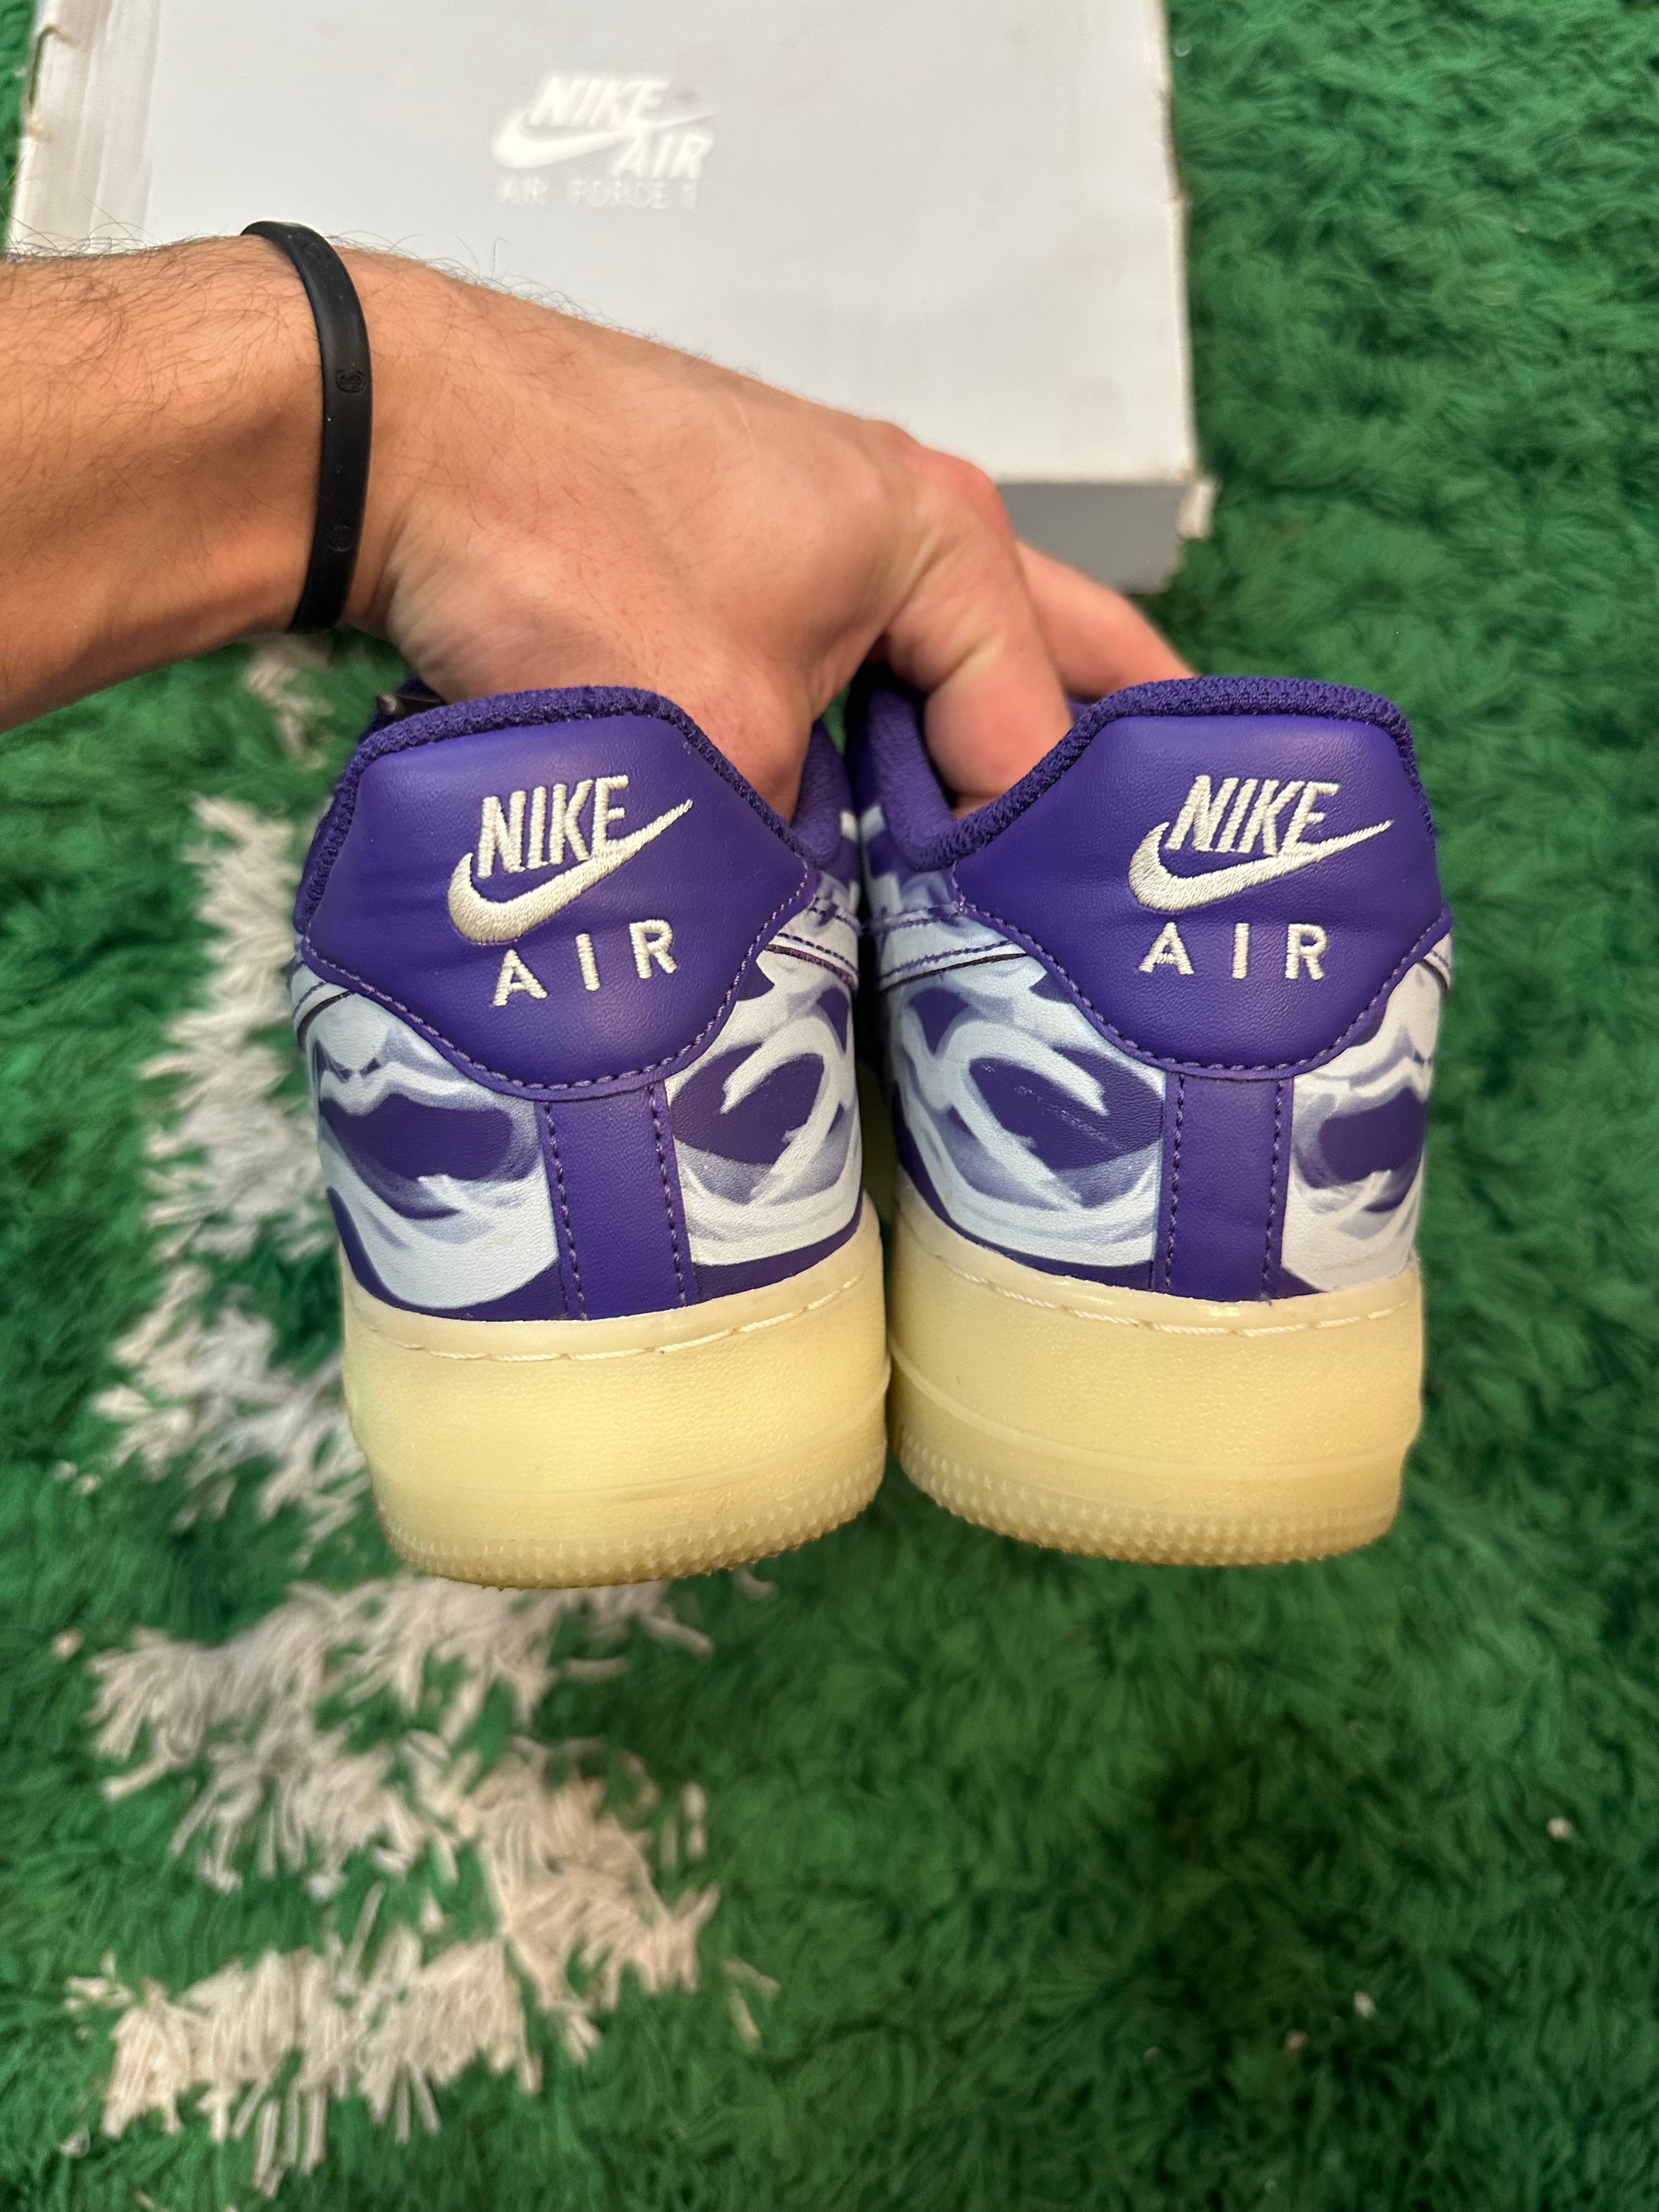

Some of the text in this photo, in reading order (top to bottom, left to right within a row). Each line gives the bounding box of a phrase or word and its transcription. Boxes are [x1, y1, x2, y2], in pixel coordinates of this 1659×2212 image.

[531, 76, 673, 127] NIKE
[610, 131, 714, 179] AIR
[476, 774, 629, 879] NIKE
[1164, 775, 1341, 856] NIKE
[493, 919, 678, 1007] AIR
[1138, 921, 1328, 980] AIR
